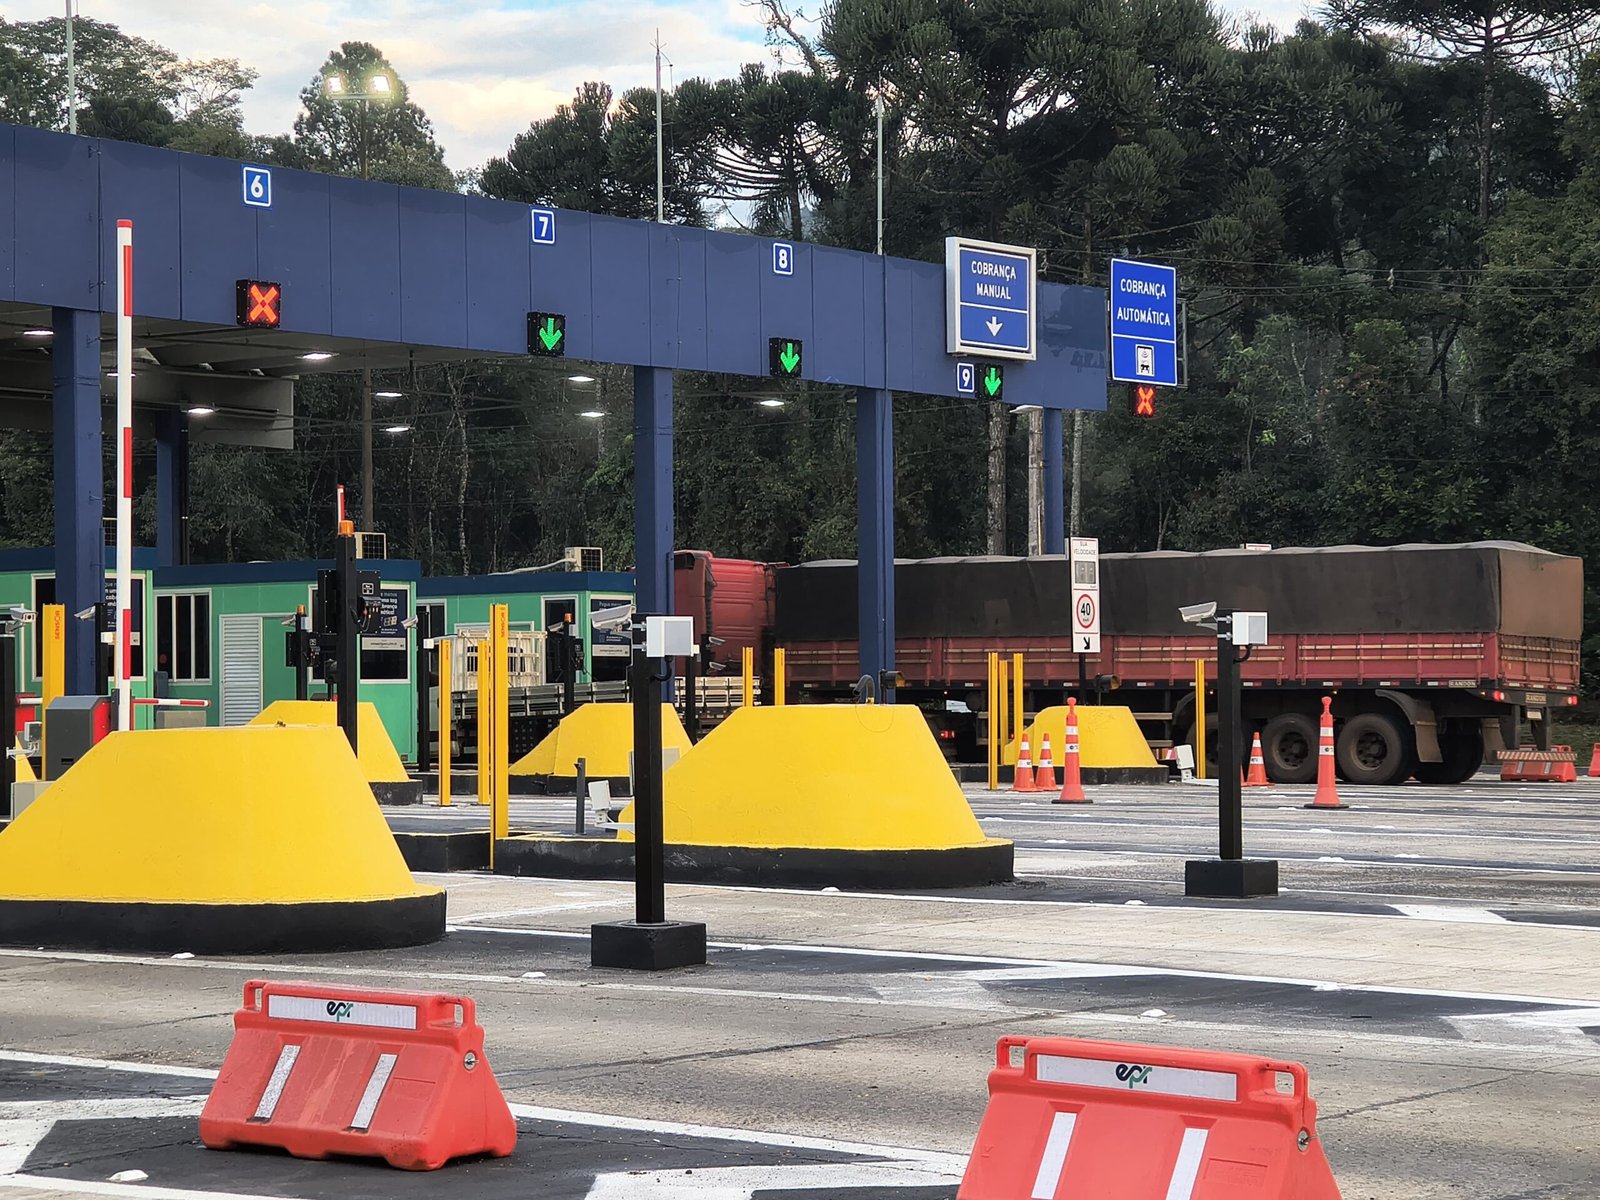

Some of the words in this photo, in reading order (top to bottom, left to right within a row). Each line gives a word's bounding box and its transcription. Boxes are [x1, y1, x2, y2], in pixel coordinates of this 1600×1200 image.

[251, 175, 263, 198] 6
[539, 216, 548, 237] 7
[779, 249, 788, 268] 8
[971, 261, 1016, 281] COBRANÇA
[976, 282, 1012, 300] MANUAL
[1120, 278, 1167, 300] COBRANÇA
[1117, 306, 1171, 327] AUTOMÁTICA
[962, 368, 970, 387] 9
[1081, 603, 1091, 616] 40
